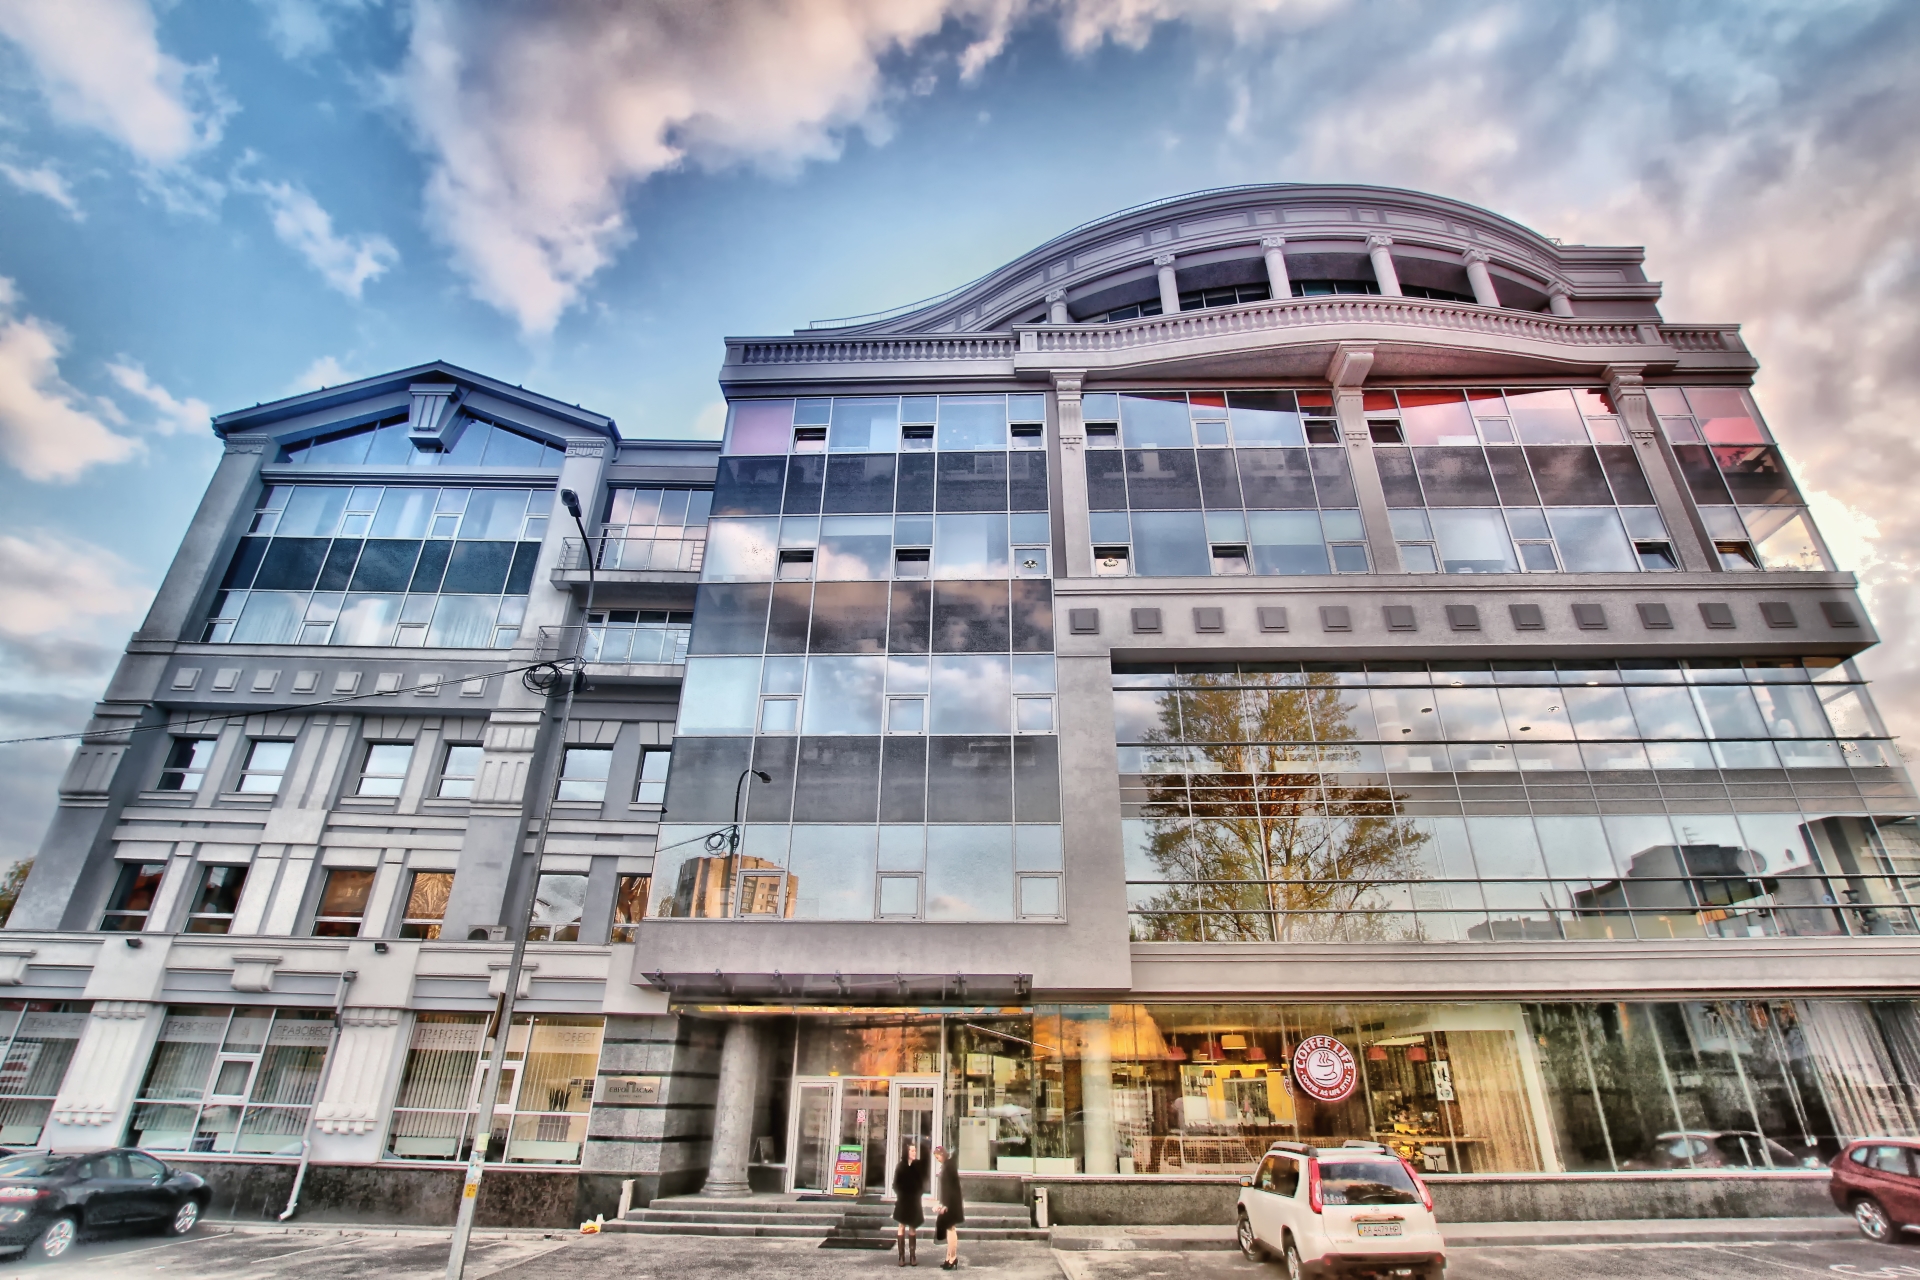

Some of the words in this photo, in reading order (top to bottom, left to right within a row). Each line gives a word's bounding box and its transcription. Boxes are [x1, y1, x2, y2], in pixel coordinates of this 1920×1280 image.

[275, 1025, 335, 1036] ПРАВОВЕСТ
[1296, 1037, 1332, 1069] COFFEE
[1333, 1042, 1354, 1070] LIFE
